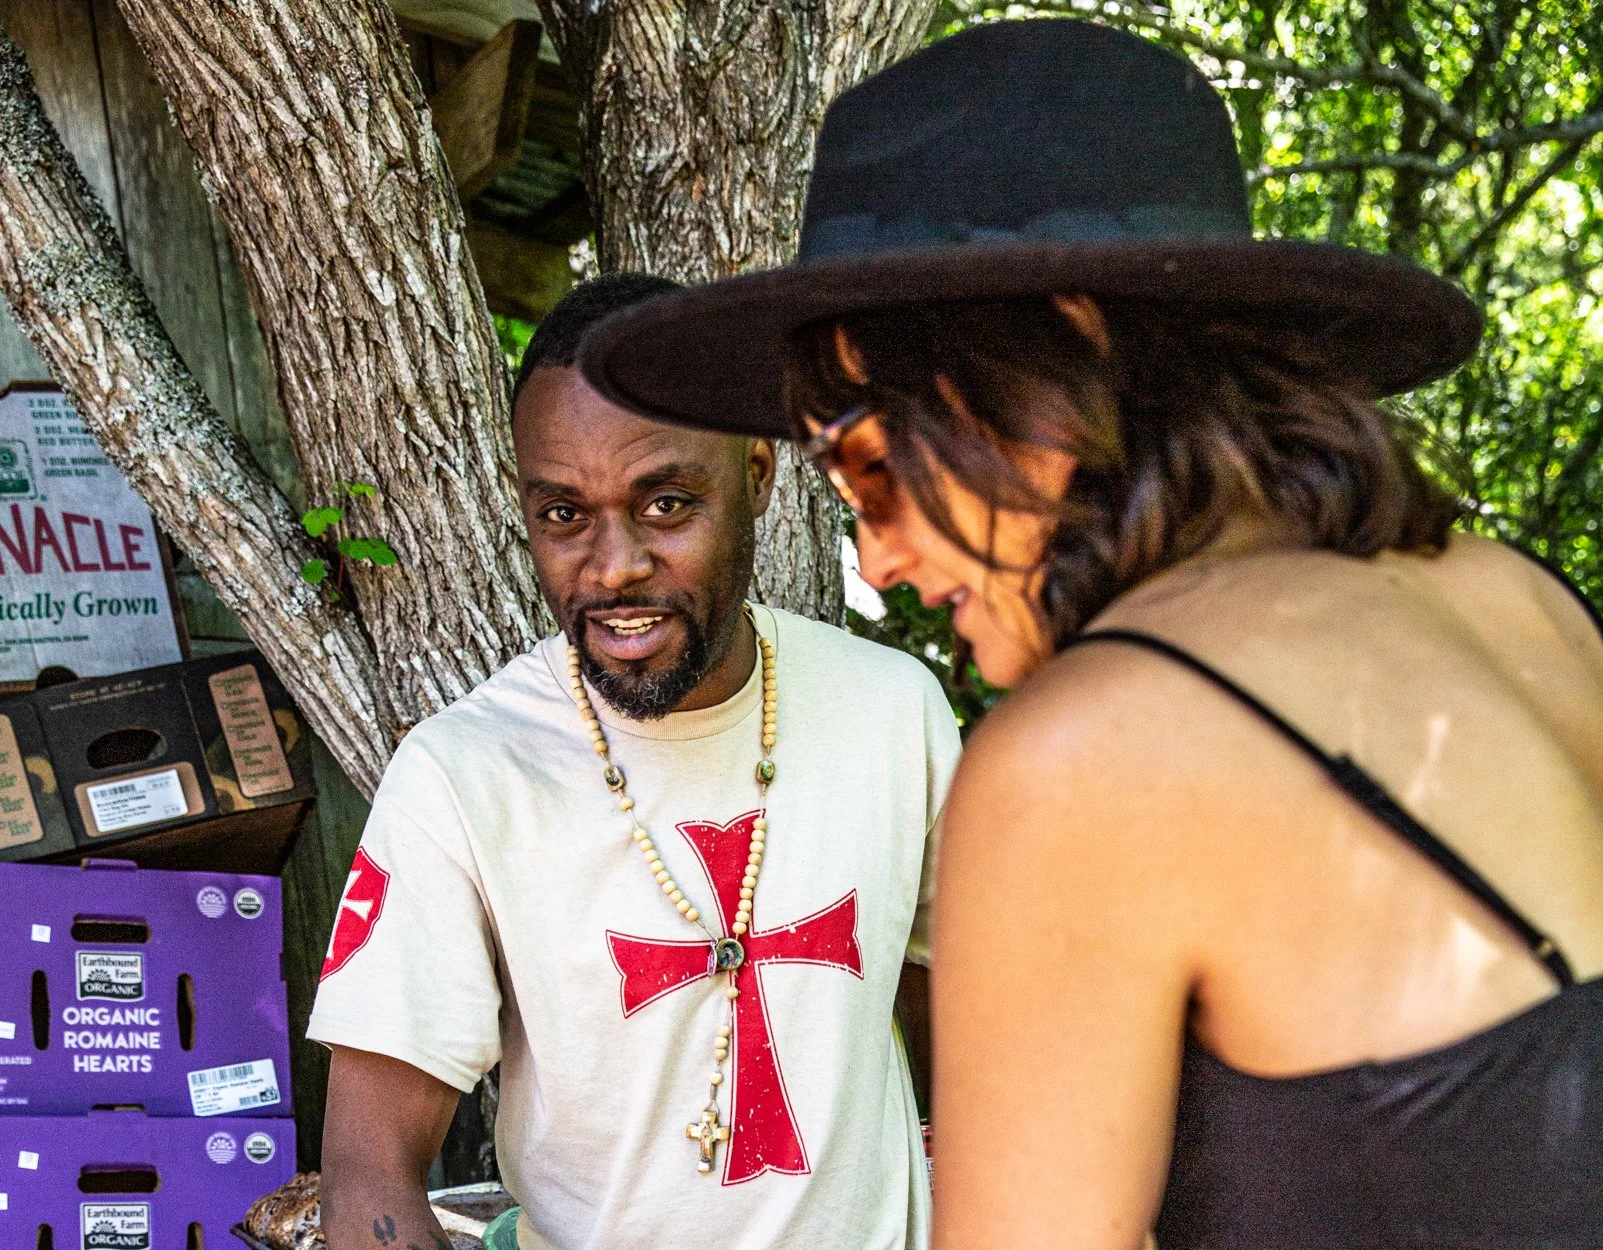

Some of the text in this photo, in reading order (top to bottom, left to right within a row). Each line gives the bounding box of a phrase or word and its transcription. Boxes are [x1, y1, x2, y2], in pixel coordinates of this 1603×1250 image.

[73, 590, 158, 618] Grown
[83, 957, 138, 967] Earthbound
[84, 982, 138, 995] ORGANIC
[62, 1007, 160, 1026] ORGANIC
[63, 1031, 160, 1049] ROMAINE
[73, 1055, 152, 1072] HEARTS
[87, 1208, 144, 1218] Earthbound
[121, 1220, 145, 1229] Farm
[88, 1234, 144, 1246] ORGANIC
